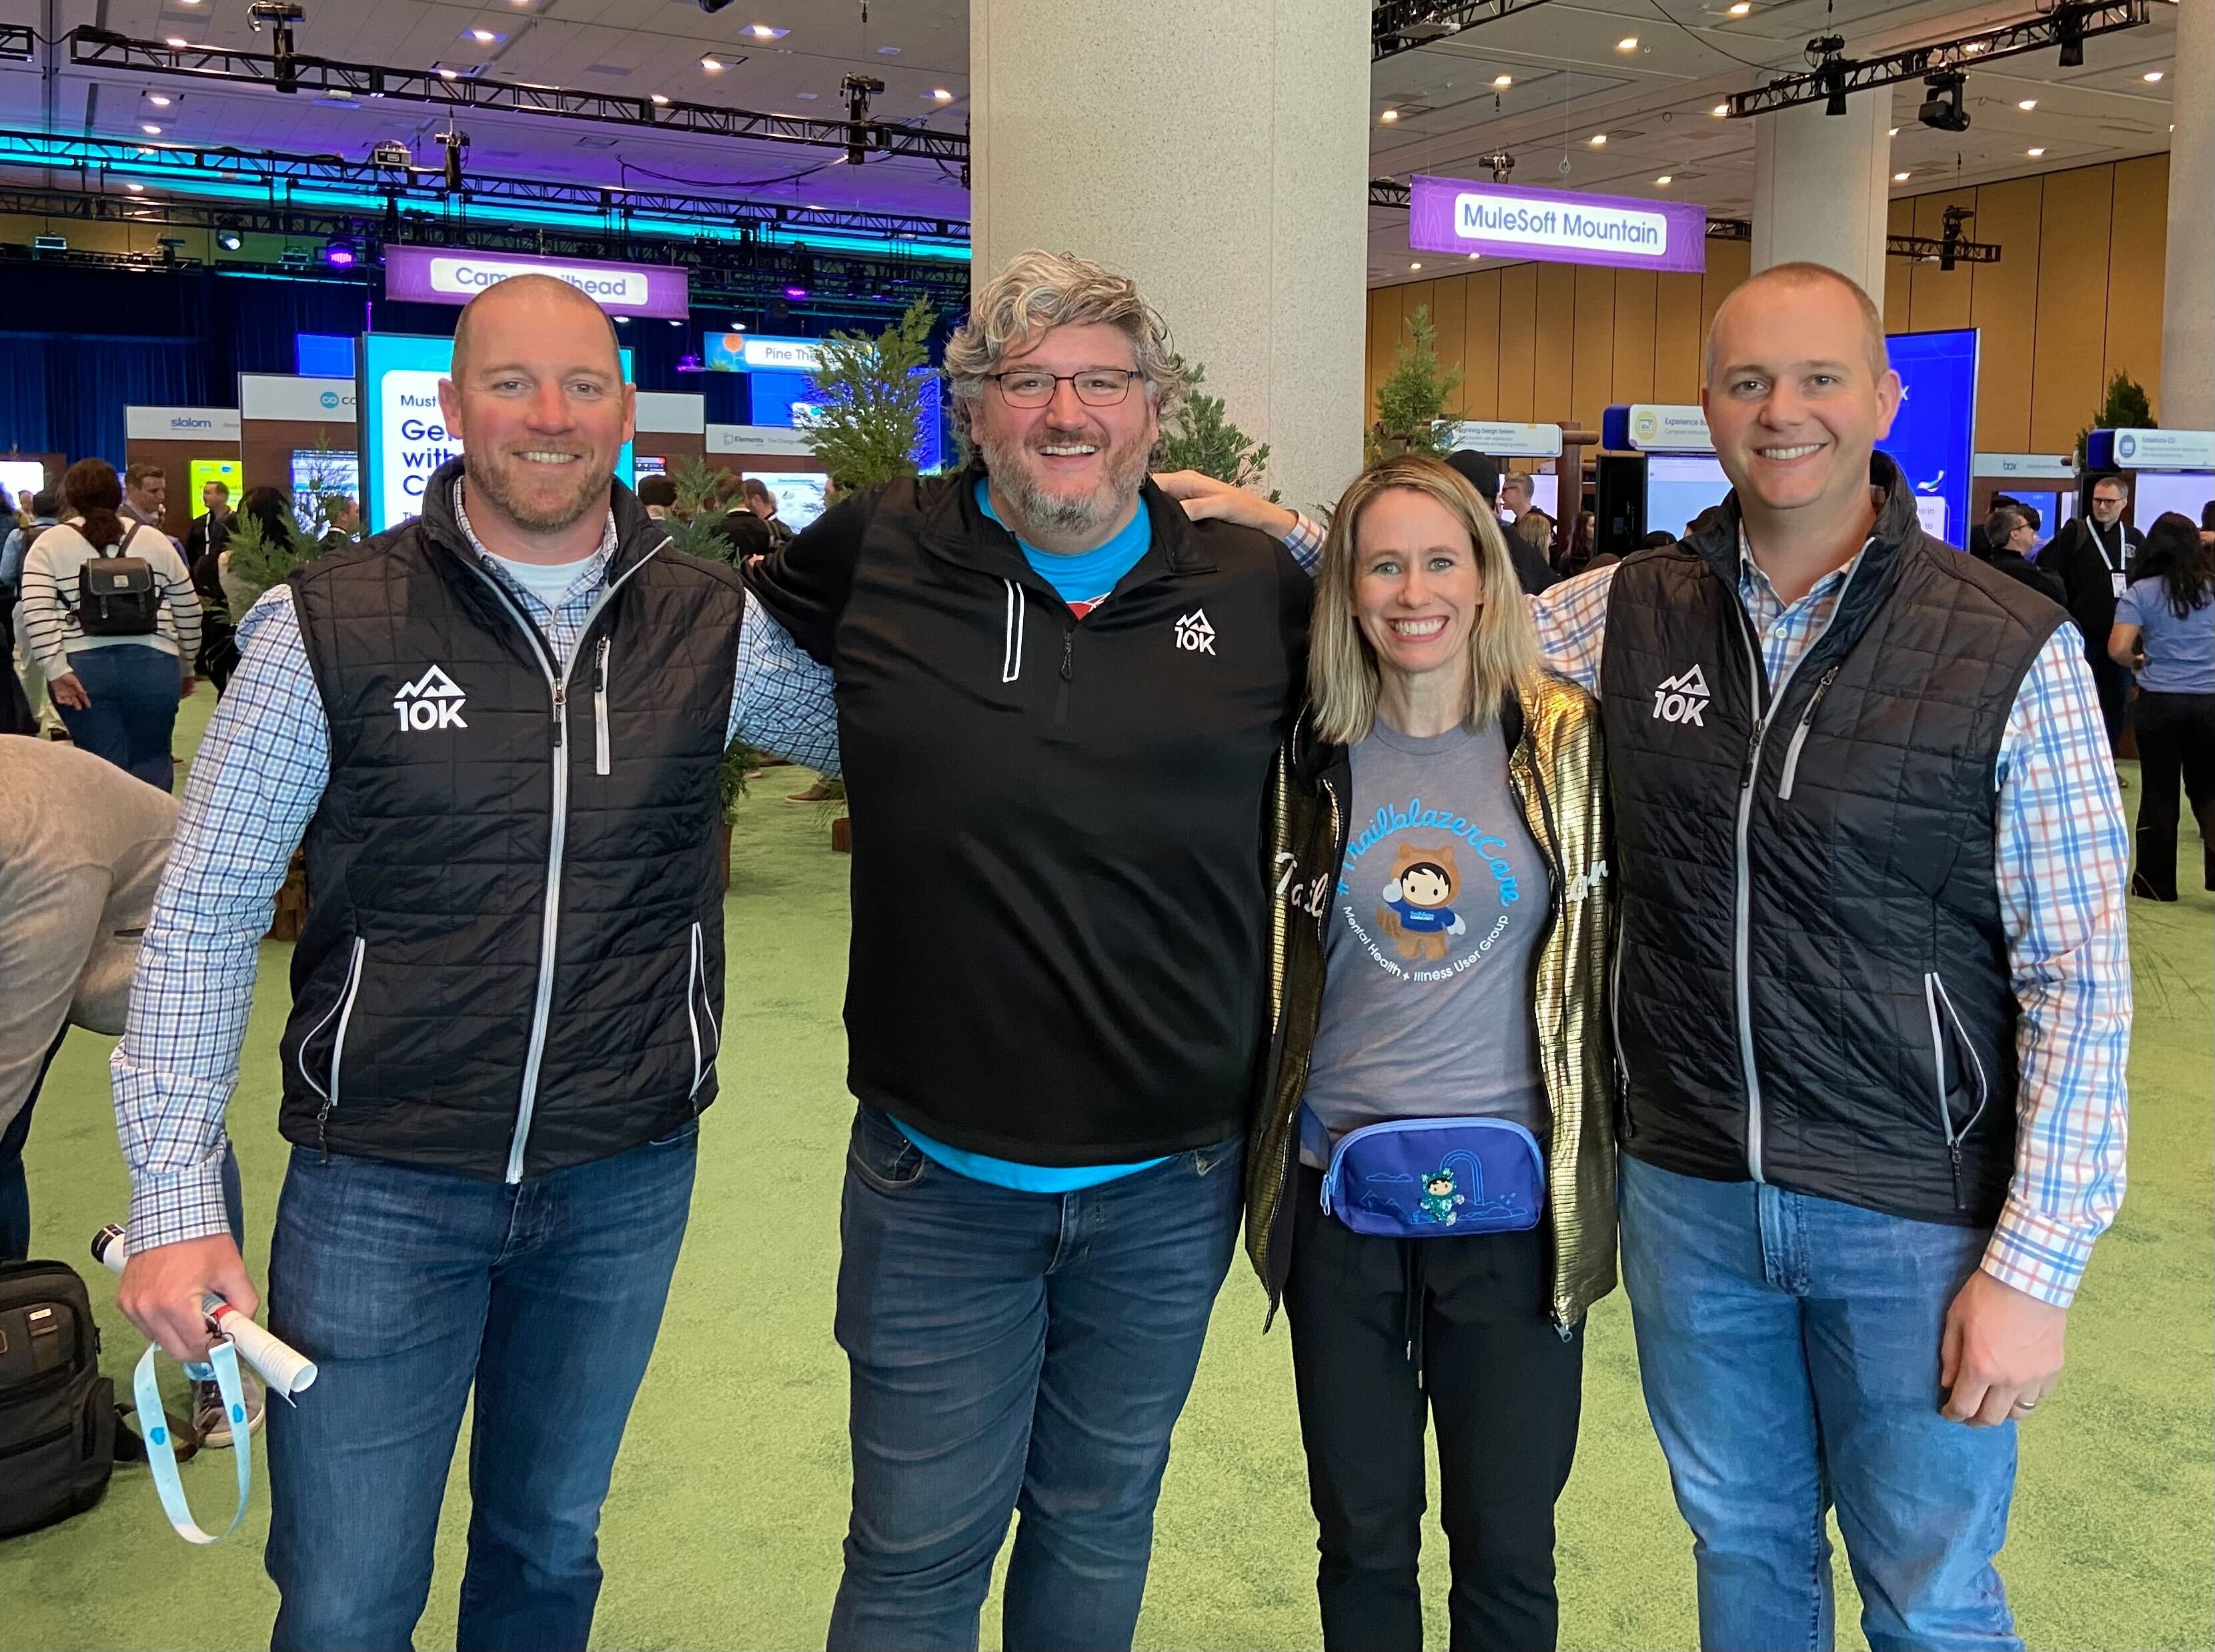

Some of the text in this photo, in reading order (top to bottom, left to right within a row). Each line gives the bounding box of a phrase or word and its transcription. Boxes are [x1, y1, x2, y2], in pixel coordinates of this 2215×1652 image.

[1464, 203, 1657, 244] MuleSoft Mountain
[455, 267, 508, 286] Cam
[766, 347, 792, 360] Pine
[401, 394, 436, 407] Must
[171, 417, 211, 428] slalom
[402, 419, 452, 442] Ge
[2003, 460, 2018, 471] box
[1174, 626, 1216, 656] 10K
[393, 698, 468, 732] 10K
[1653, 690, 1709, 727] 10K
[1343, 906, 1372, 946] Mental
[1367, 943, 1401, 978] Health
[1413, 965, 1454, 982] Illness
[1458, 950, 1481, 972] User
[1479, 914, 1509, 952] Group
